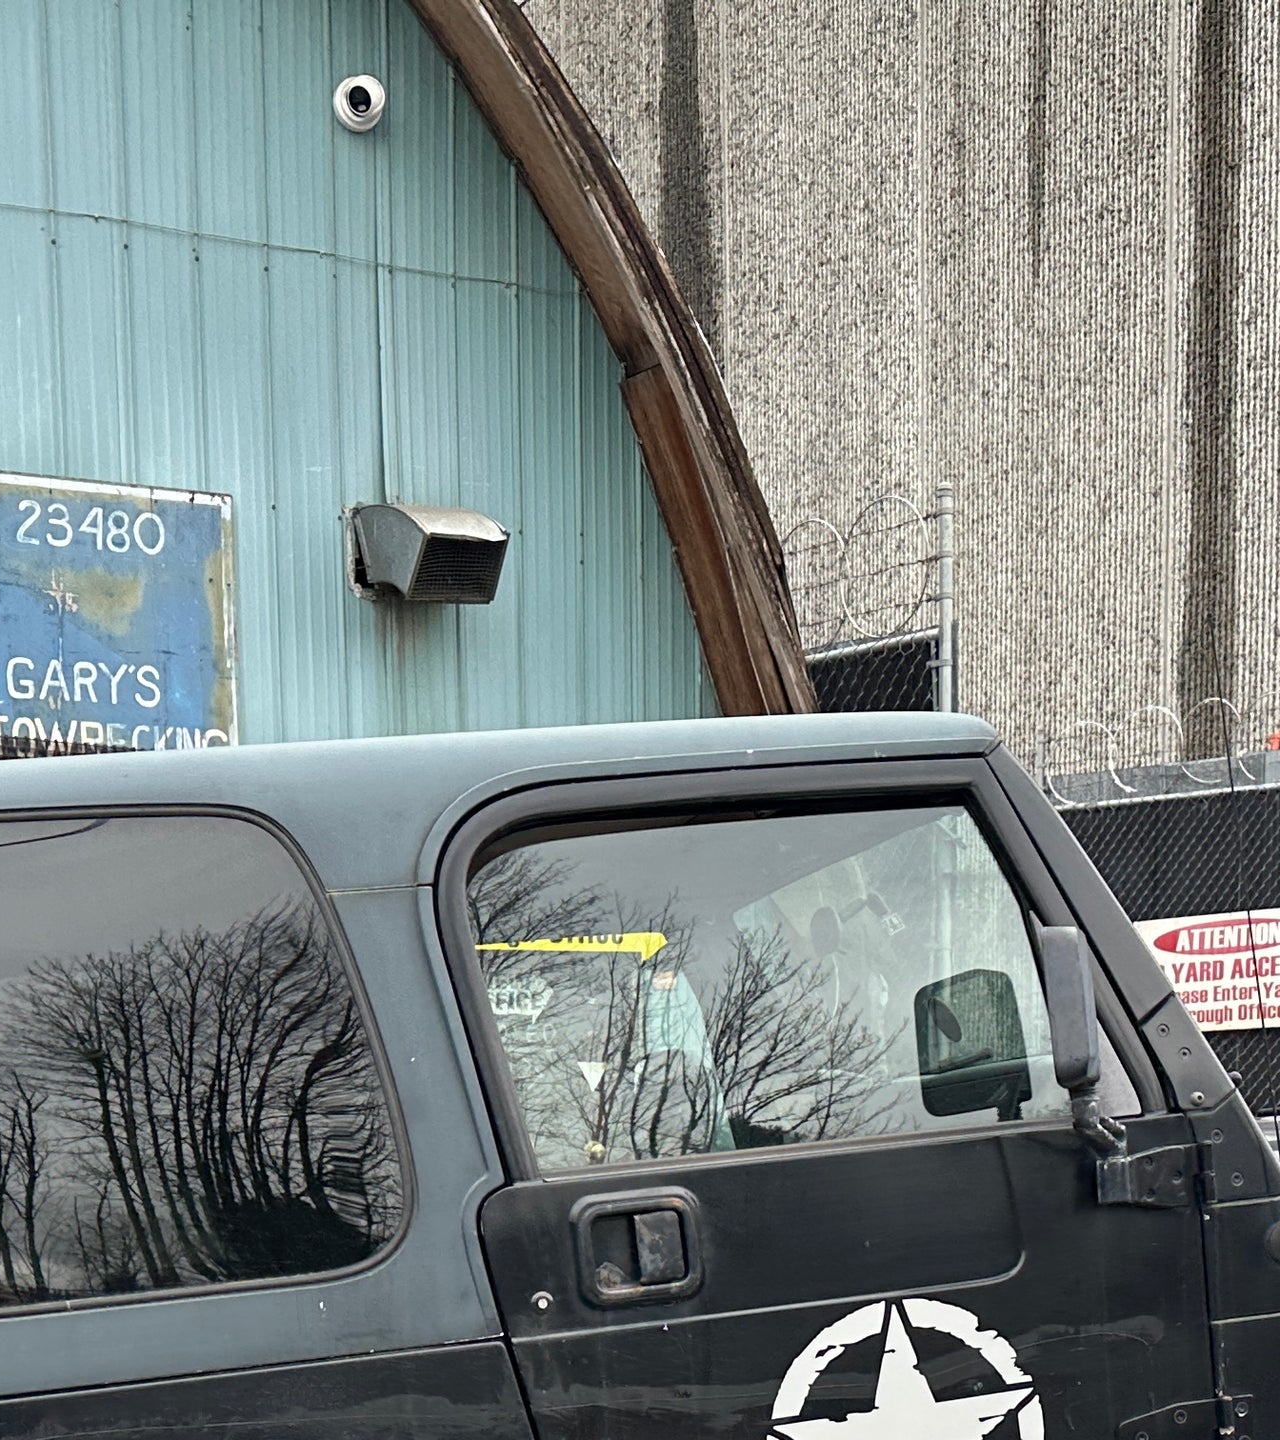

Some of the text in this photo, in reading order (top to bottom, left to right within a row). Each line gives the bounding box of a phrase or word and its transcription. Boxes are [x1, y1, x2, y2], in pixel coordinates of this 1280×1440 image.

[16, 499, 167, 556] 23480
[6, 656, 161, 708] GARY'S
[1171, 960, 1223, 984] YARD
[1177, 989, 1208, 1004] ase
[1213, 984, 1258, 1002] Enter
[1189, 1001, 1233, 1025] rough
